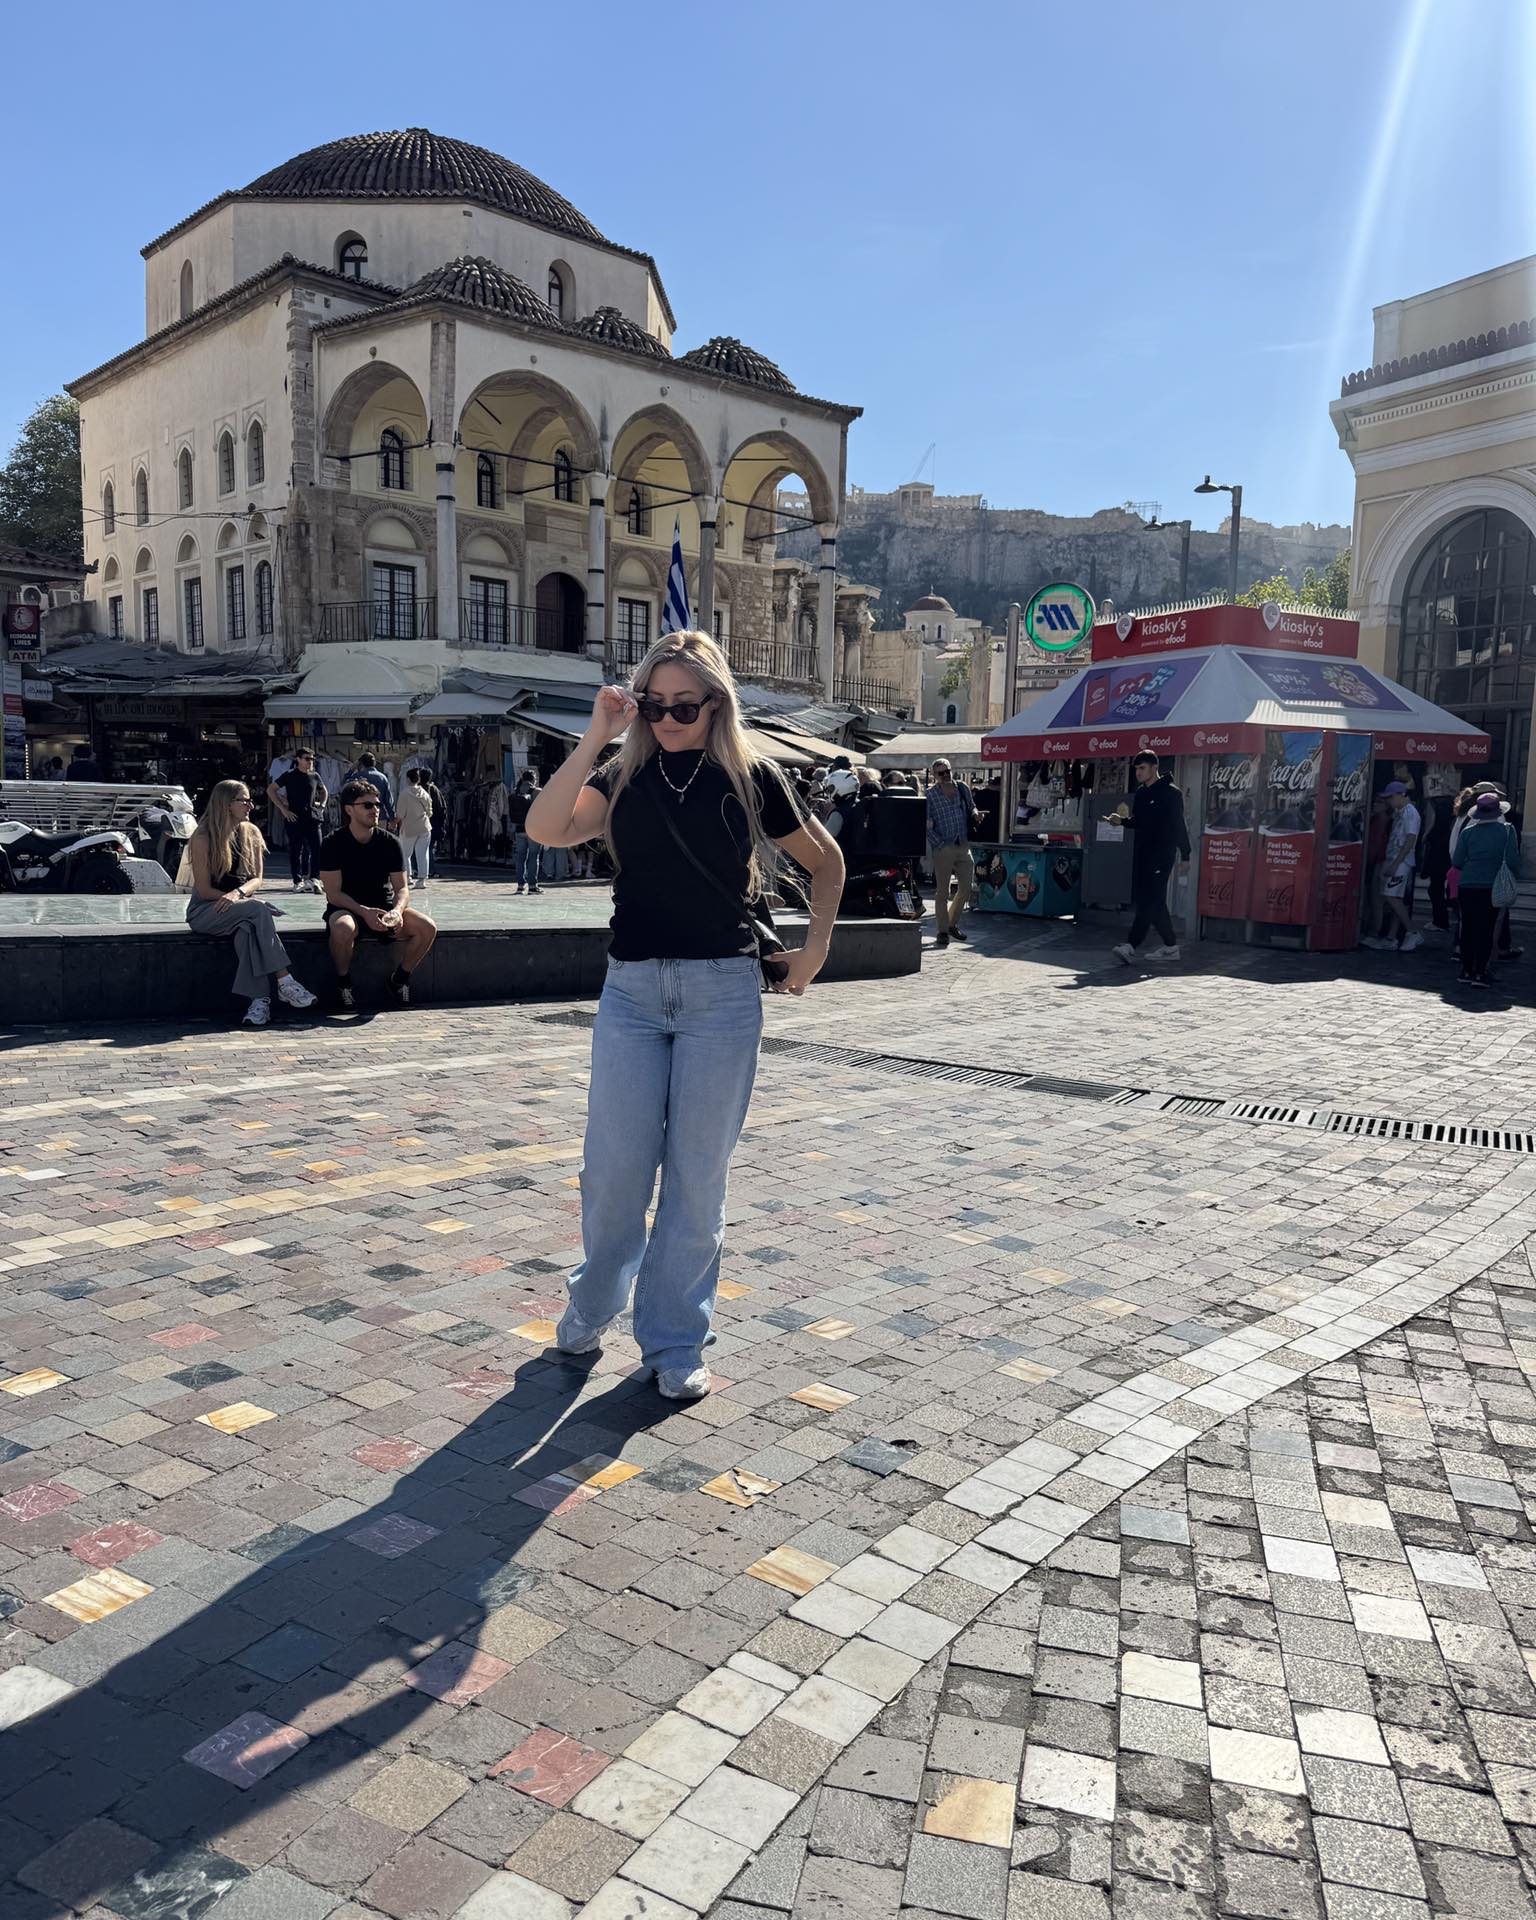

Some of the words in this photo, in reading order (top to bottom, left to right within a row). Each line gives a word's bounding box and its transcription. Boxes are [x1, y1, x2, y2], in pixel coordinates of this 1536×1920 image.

[1142, 618, 1187, 636] kiosky's
[1280, 617, 1324, 636] kiosky's
[1165, 633, 1186, 645] efood
[1303, 638, 1323, 648] efood
[13, 651, 38, 661] ATM
[1150, 736, 1171, 746] efood
[1206, 733, 1229, 744] efood
[1053, 742, 1070, 752] efood
[1099, 739, 1119, 749] efood
[1417, 743, 1437, 753] efood
[1223, 847, 1240, 855] Magic
[1282, 850, 1301, 858] Magic
[1273, 857, 1297, 865] Greece!
